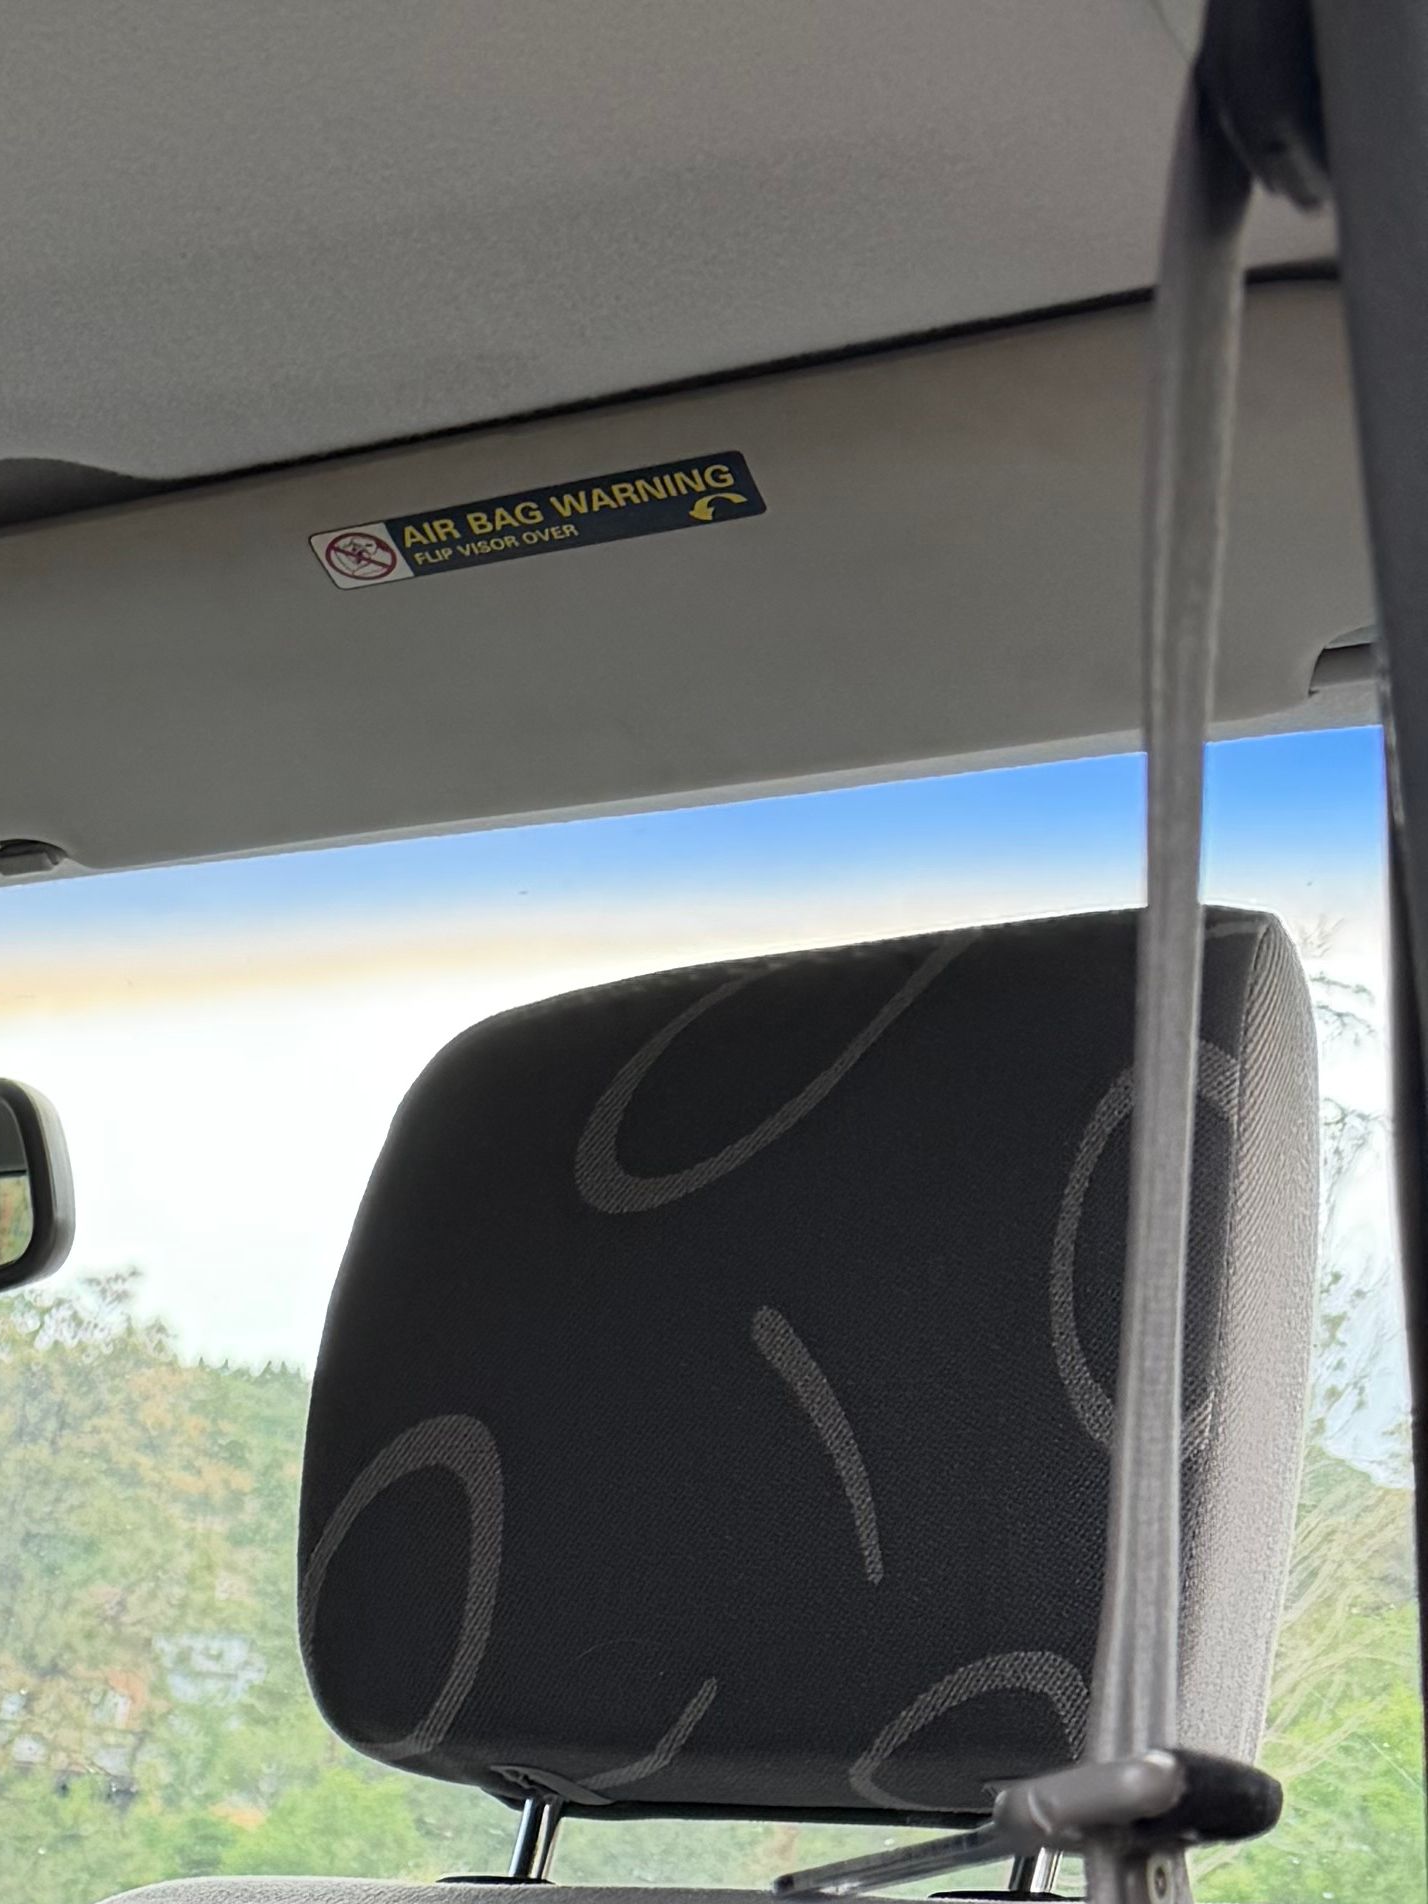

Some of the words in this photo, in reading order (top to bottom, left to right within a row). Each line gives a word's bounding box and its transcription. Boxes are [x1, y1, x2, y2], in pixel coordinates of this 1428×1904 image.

[403, 519, 461, 547] AIR
[465, 501, 545, 535] BAG
[549, 464, 735, 518] WARNING
[414, 546, 453, 566] FLIP
[456, 535, 520, 557] VISOR
[525, 523, 580, 545] OVER
